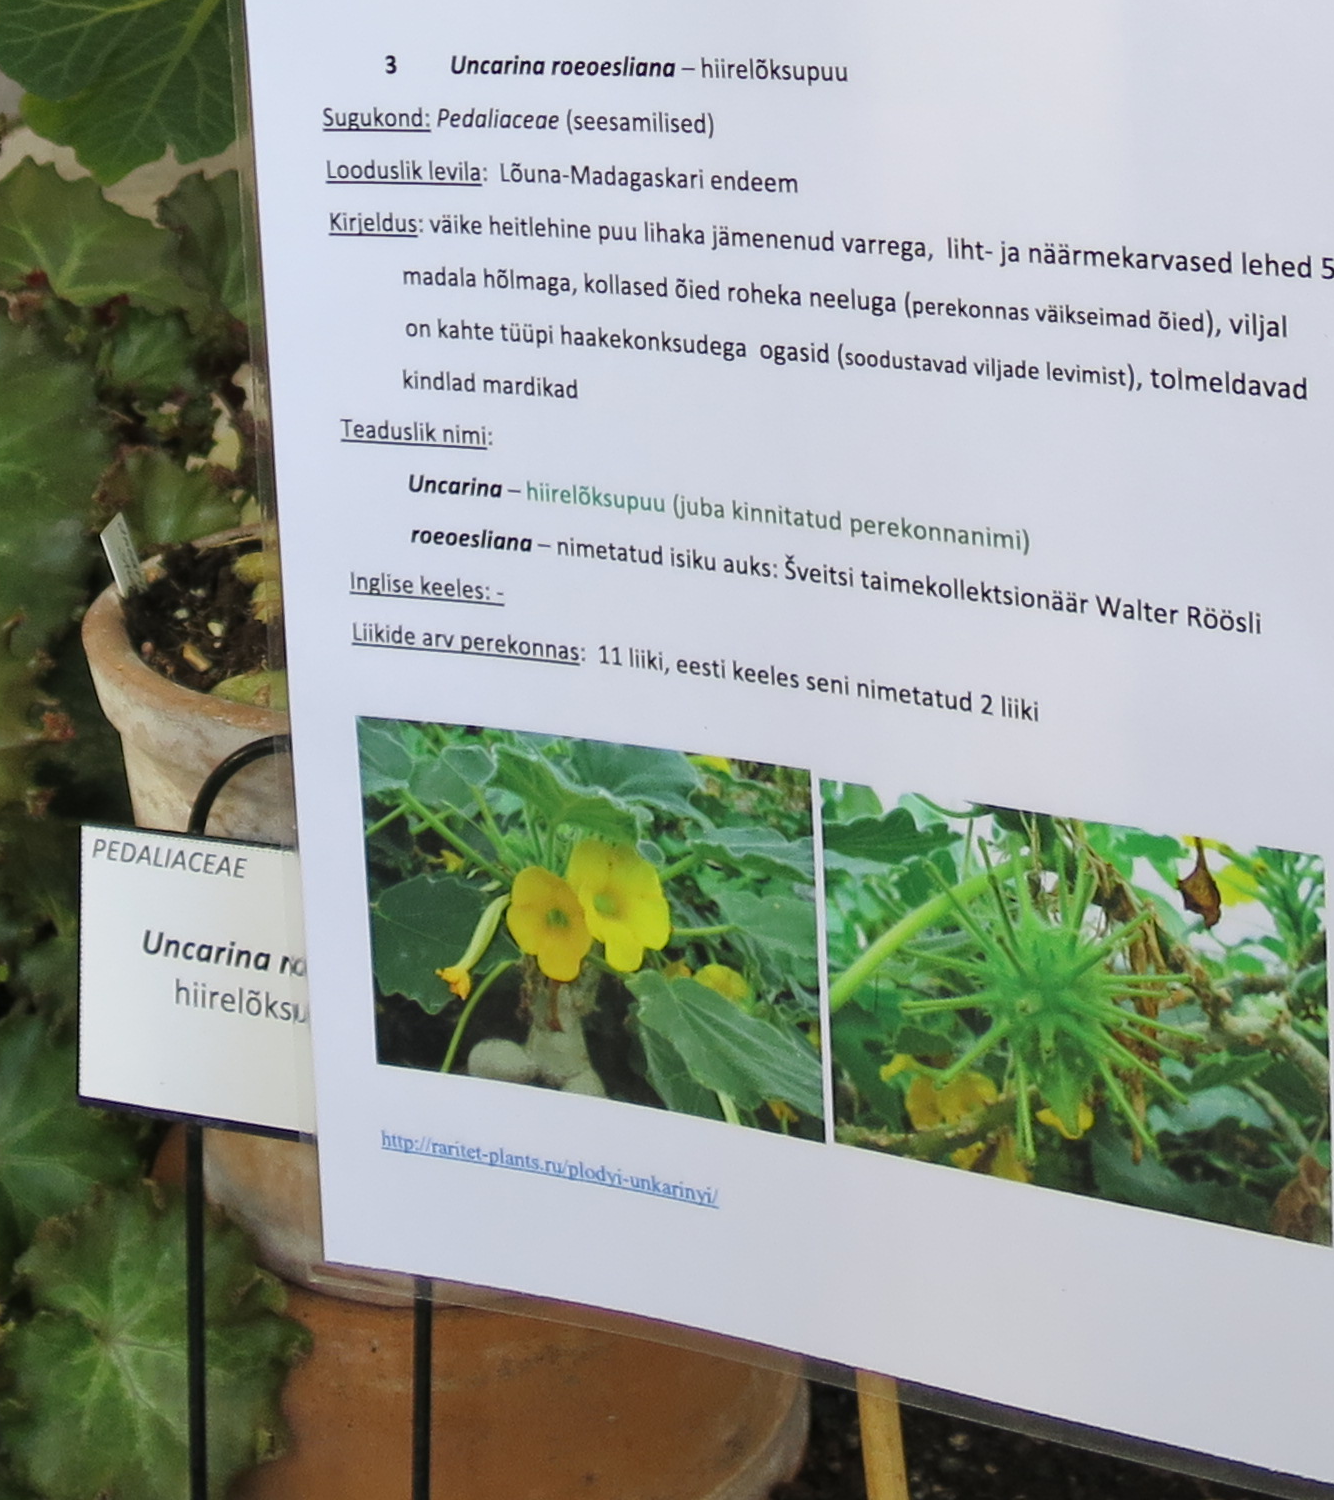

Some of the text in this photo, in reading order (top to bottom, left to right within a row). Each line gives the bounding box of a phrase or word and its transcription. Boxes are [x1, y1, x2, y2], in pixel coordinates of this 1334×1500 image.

[384, 56, 397, 74] 3
[450, 55, 545, 76] Uncarina
[551, 57, 676, 78] roeoesliana
[700, 57, 849, 86] hiirelõksupuu
[322, 107, 715, 138] Sugukond: Pedaliaceae (seesamilised)
[326, 160, 799, 194] Looduslik levila: Lõuna-Madagaskari endeem
[329, 213, 424, 237] Kirjeldus:
[429, 215, 483, 237] väike
[488, 216, 592, 241] heitlehine
[597, 225, 637, 244] puu
[643, 222, 705, 246] lihaka
[710, 225, 835, 254] jämenenud
[841, 236, 934, 263] varrega,
[946, 236, 993, 261] liht-
[999, 240, 1020, 267] ja
[1027, 241, 1233, 275] näärmekarvased
[1241, 253, 1313, 279] lehed
[402, 267, 1288, 340] madala hõlmaga, kollased õied roheka neeluga (perekonnas väikseimad õied), viljal
[405, 319, 1308, 400] on kahte tüüpi haakekonksudega ogasid (soodustavad viljade levimist), tolmeldavad
[402, 370, 578, 400] kindlad mardikad
[340, 419, 494, 446] Teaduslik nimi:
[408, 474, 503, 498] Uncarina
[526, 481, 666, 515] hiirelõksupuu
[672, 493, 725, 520] (juba
[731, 499, 842, 532] kinnitatud
[849, 510, 1031, 555] perekonnanimi)
[349, 571, 415, 597] Inglise
[420, 573, 492, 602] keeles:
[410, 527, 533, 553] roeoesliana
[556, 536, 664, 566] nimetatud
[669, 547, 717, 571] isiku
[723, 553, 778, 579] auks:
[784, 553, 855, 588] Šveitsi
[860, 567, 1088, 614] taimekollektsionäär
[1096, 594, 1179, 626] Walter
[1187, 605, 1262, 635] Röösli
[352, 622, 1039, 723] Liikide arv perekonnas: 11 liiki, eesti keeles seni nimetatud 2 liiki
[92, 838, 248, 879] PEDALIACEAE
[141, 929, 271, 972] Uncarina
[175, 978, 311, 1025] hiirelõksu
